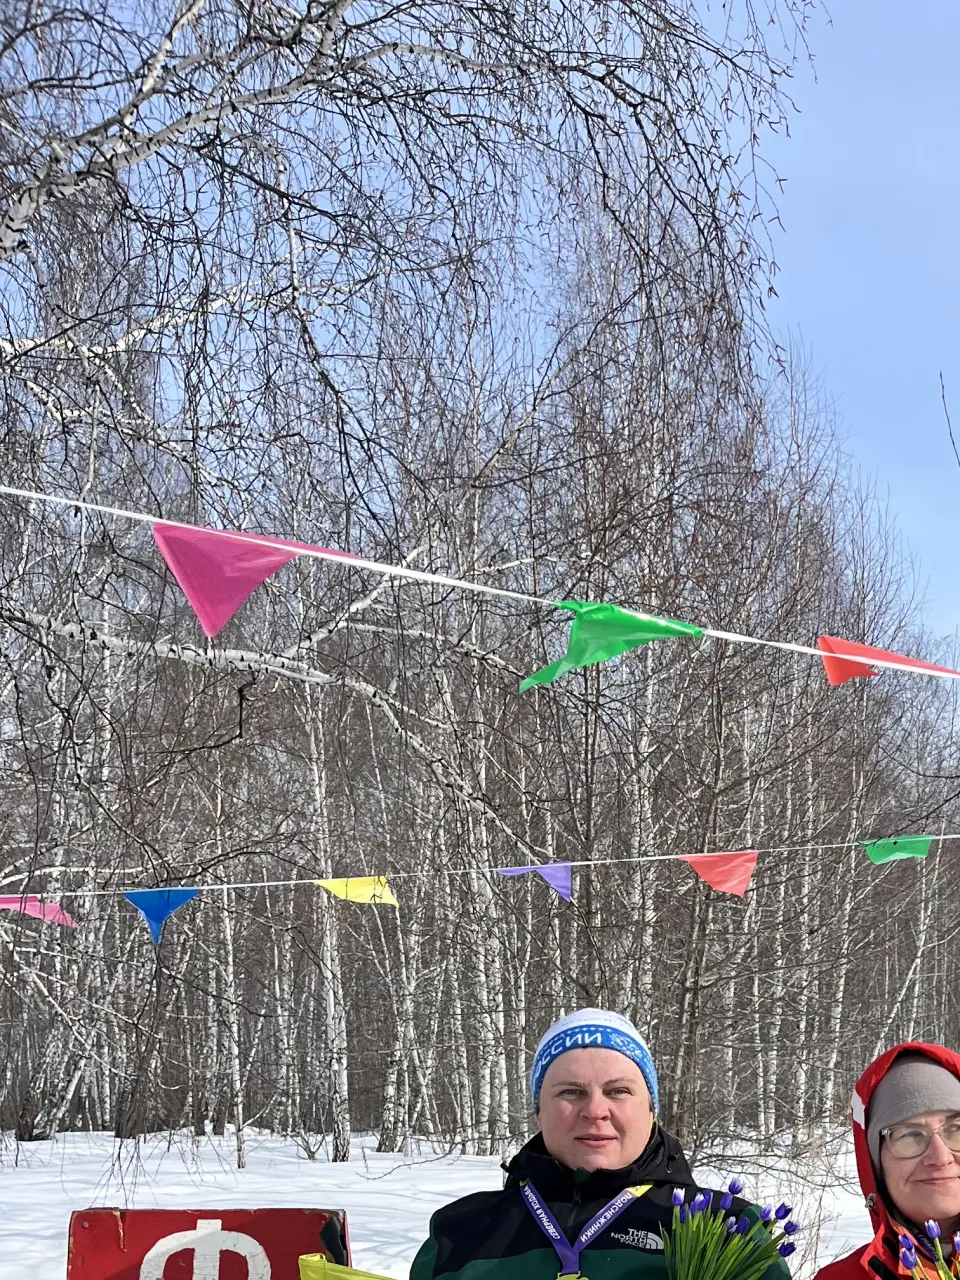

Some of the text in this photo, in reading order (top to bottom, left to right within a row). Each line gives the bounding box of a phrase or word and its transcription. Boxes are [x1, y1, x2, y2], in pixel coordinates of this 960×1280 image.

[523, 1184, 561, 1240] СЕВЕРНАЯ ХОДЬБА
[580, 1191, 633, 1243] ПОДСНЕЖНИКИ
[610, 1232, 647, 1245] NORTH
[627, 1228, 648, 1239] THE
[620, 1239, 646, 1249] FACE
